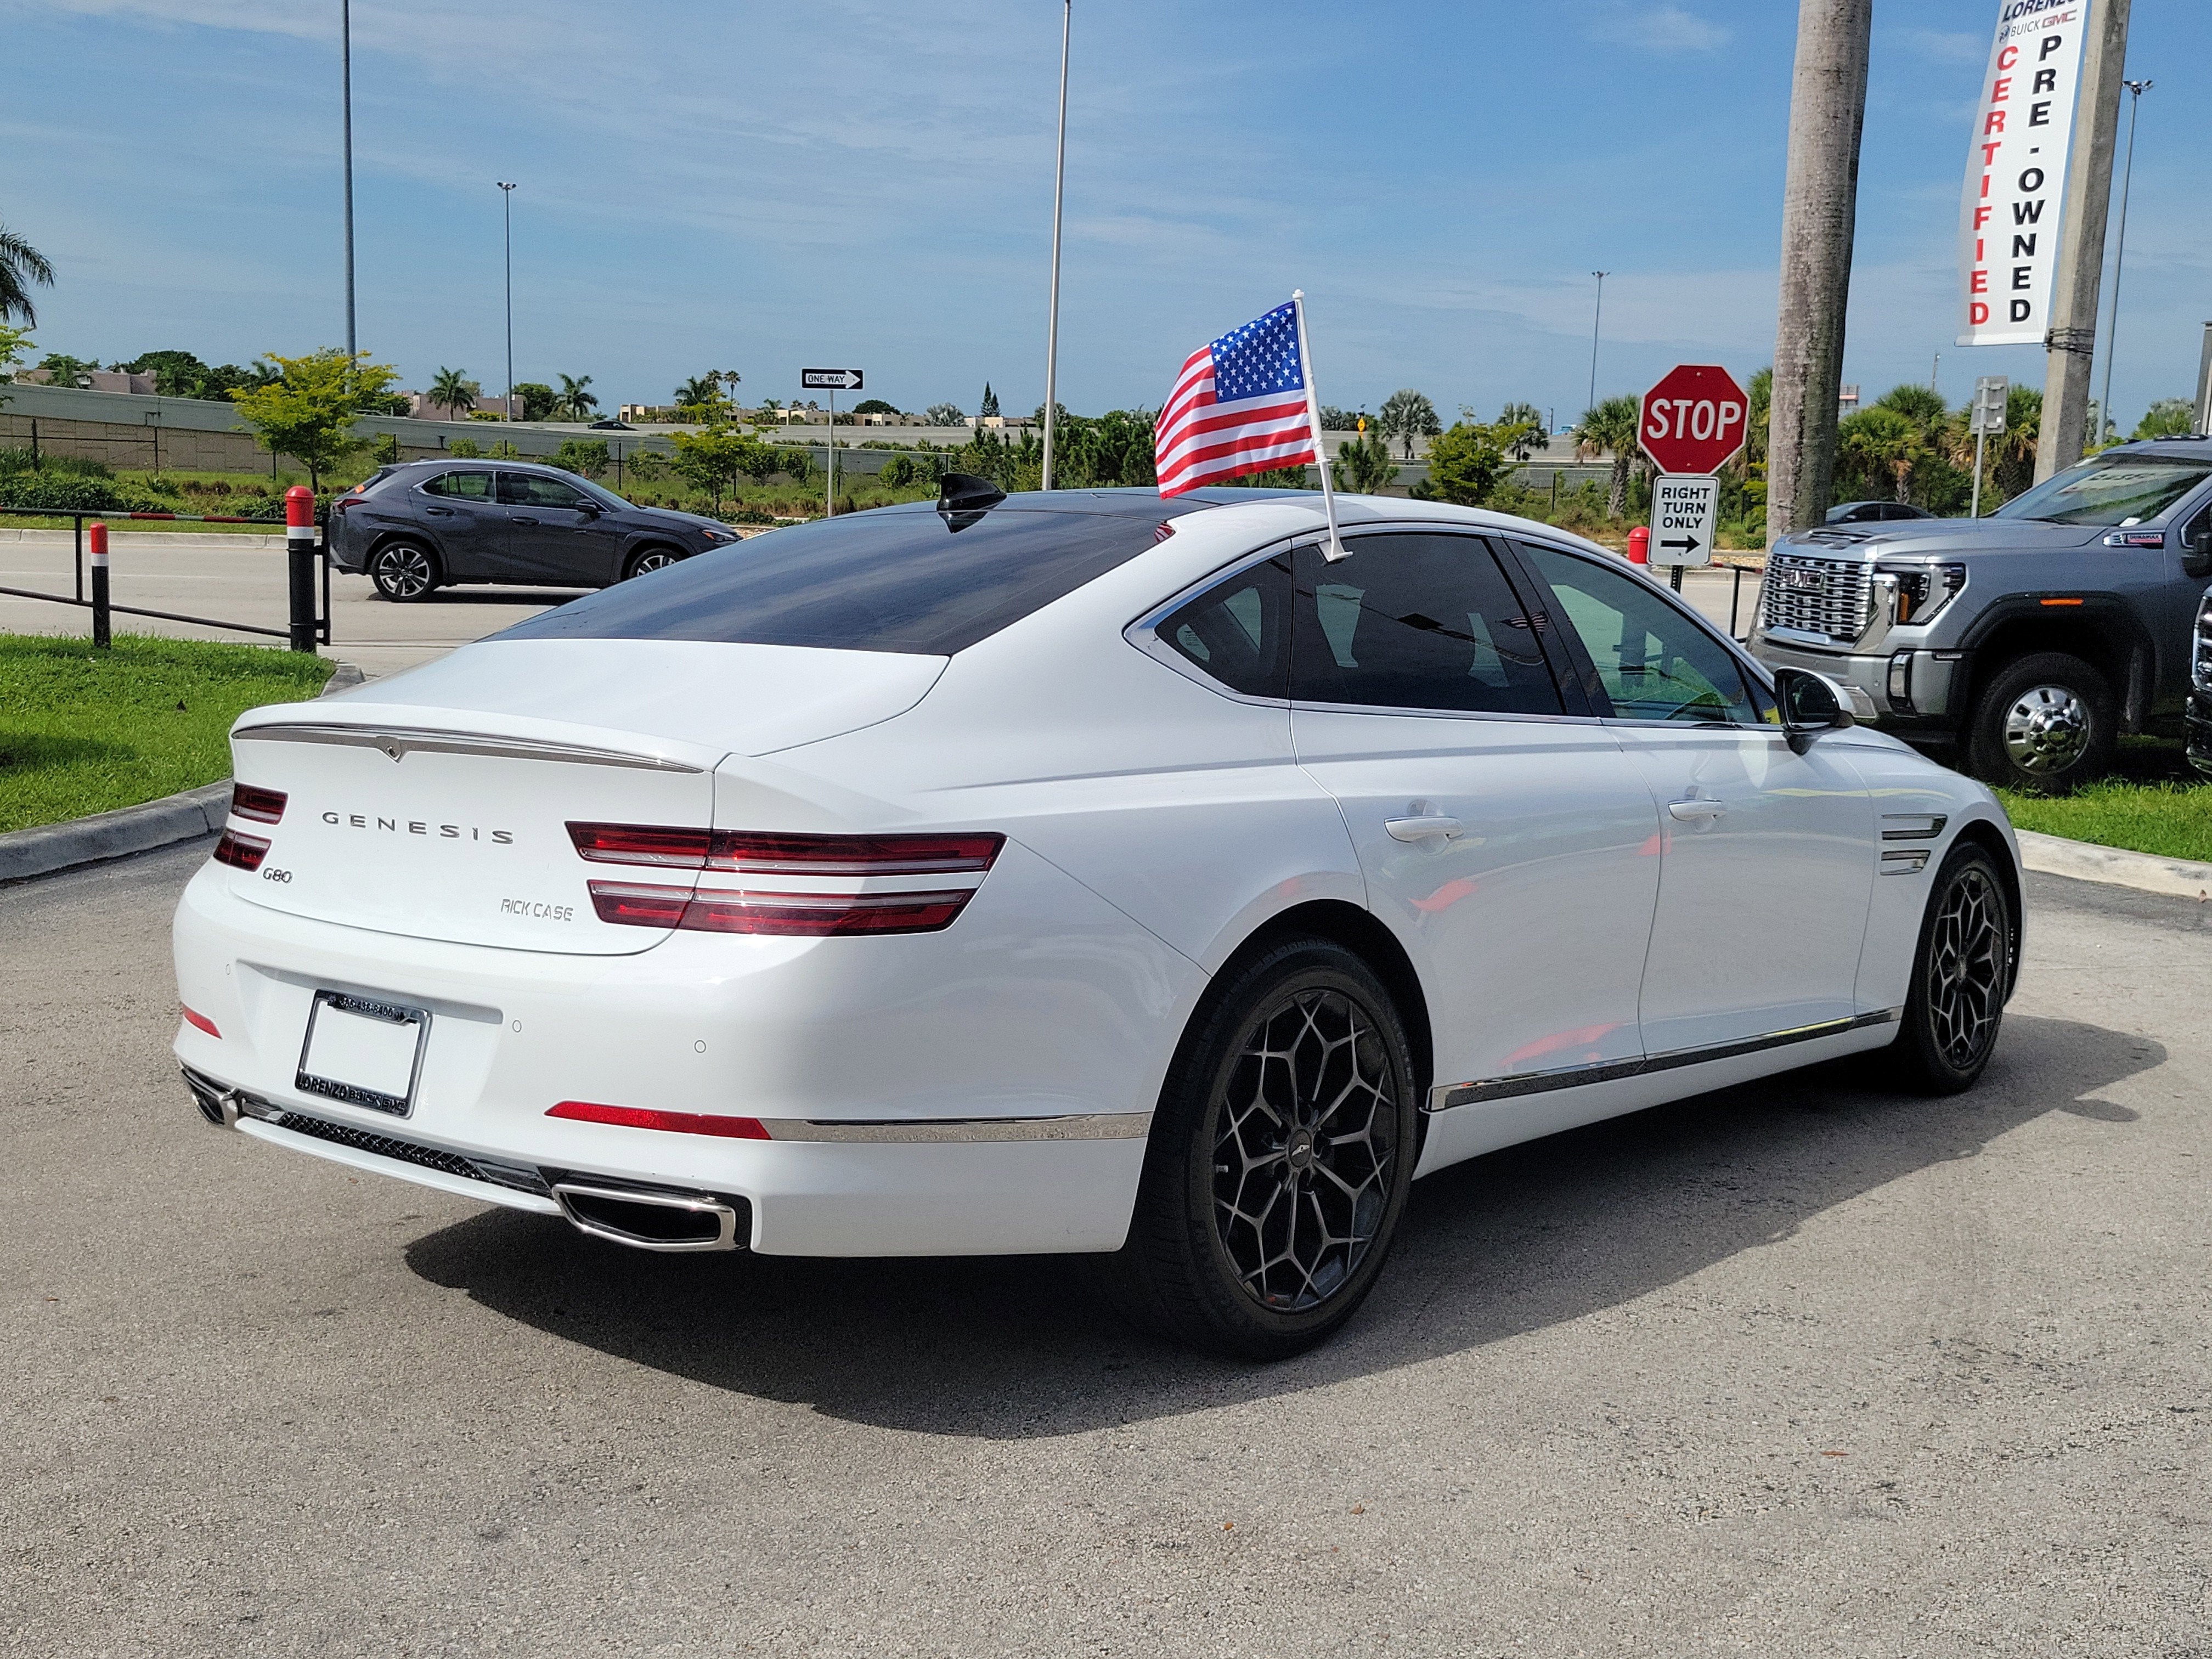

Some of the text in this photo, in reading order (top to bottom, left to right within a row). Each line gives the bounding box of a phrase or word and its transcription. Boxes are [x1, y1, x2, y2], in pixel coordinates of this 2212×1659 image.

[2002, 0, 2076, 22] LOREN
[2010, 9, 2077, 37] BUICK GMC
[1970, 46, 2019, 325] CERTIFIED
[808, 375, 825, 383] ONE
[1647, 398, 1741, 441] STOP
[1661, 487, 1710, 499] RIGHT
[1663, 502, 1706, 514] TURN
[1662, 517, 1703, 529] ONLY
[322, 812, 513, 844] GENESIS
[263, 867, 292, 883] G80
[501, 899, 573, 922] RICK CASE
[298, 1076, 348, 1098] LORENZO
